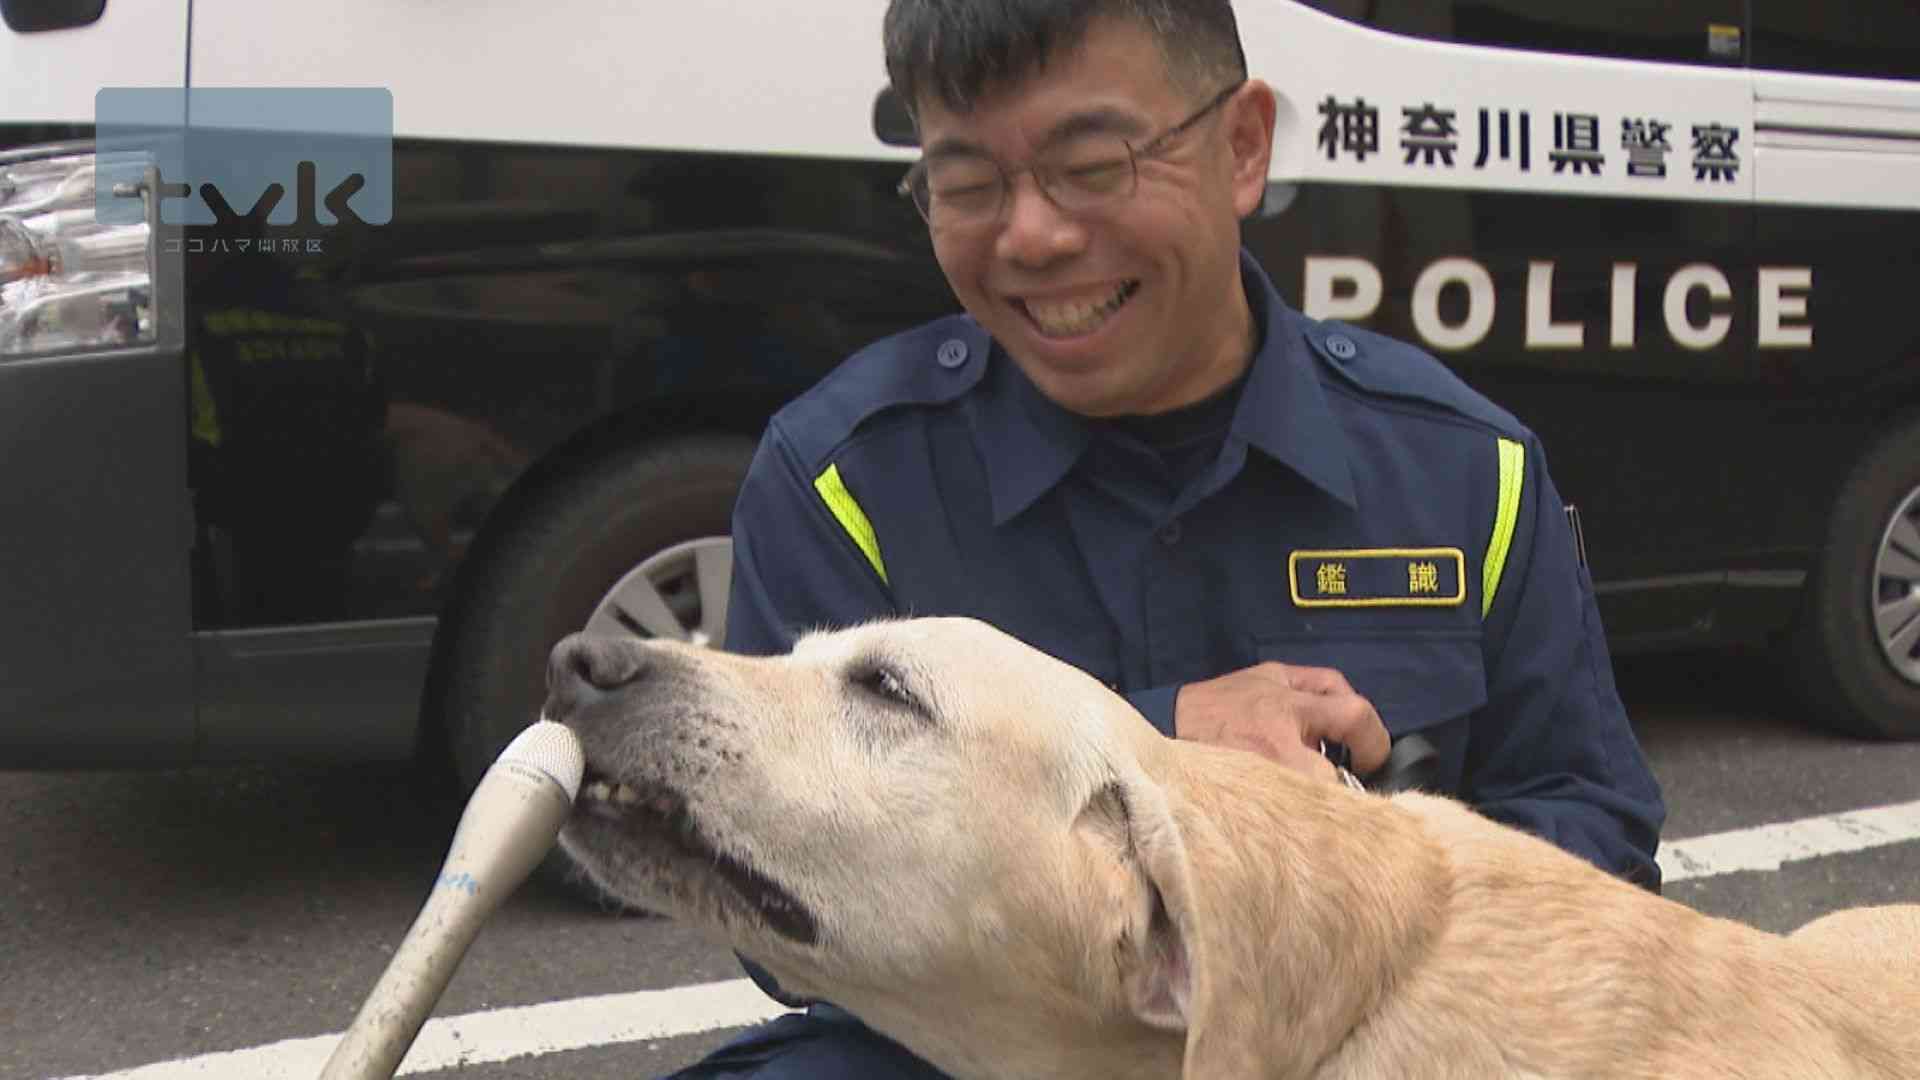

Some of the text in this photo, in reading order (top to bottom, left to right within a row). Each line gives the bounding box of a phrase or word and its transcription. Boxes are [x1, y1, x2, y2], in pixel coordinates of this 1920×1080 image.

[1318, 97, 1741, 182] 神奈川県警察
[1303, 256, 1814, 350] POLICE
[1317, 561, 1439, 594] 鑑識
